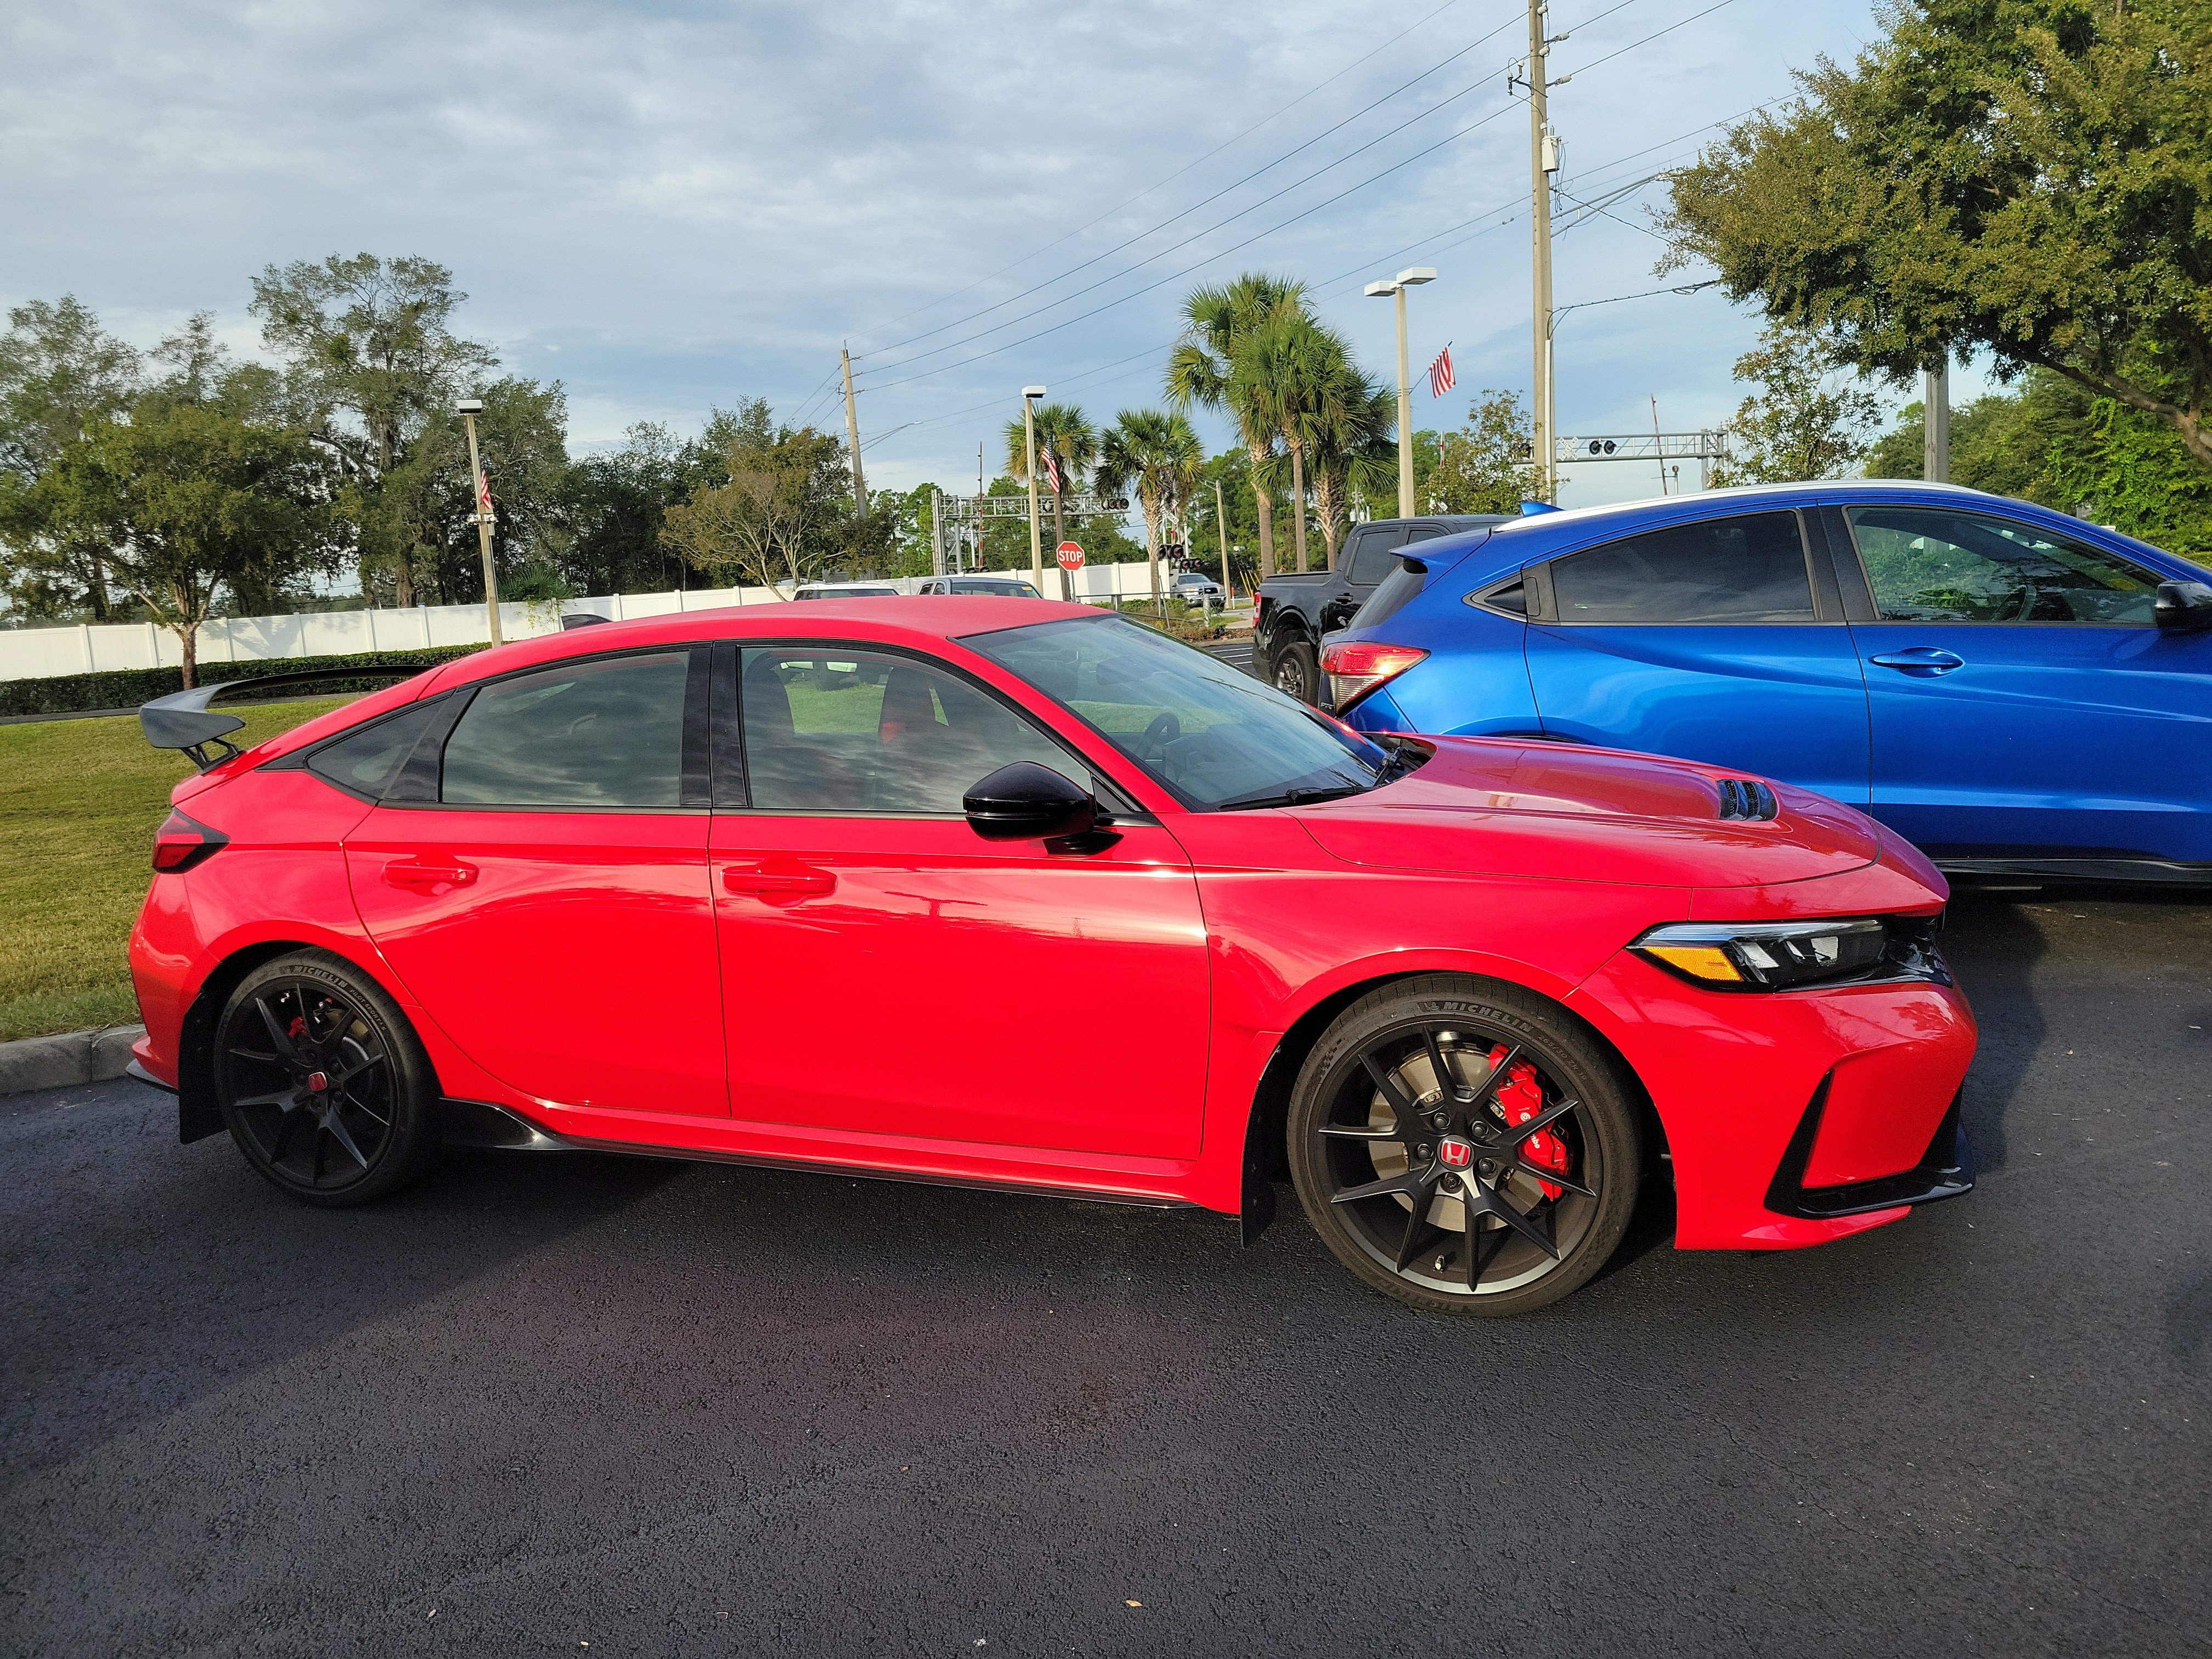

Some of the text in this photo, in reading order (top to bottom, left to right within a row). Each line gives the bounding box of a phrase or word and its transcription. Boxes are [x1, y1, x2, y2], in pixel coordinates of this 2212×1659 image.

[1059, 550, 1082, 562] STOP
[294, 965, 348, 988] MICHELIN
[350, 989, 365, 1003] PILOT
[365, 1003, 381, 1022] SPORT
[1443, 1002, 1533, 1033] MICHELIN
[1538, 1035, 1567, 1058] 265/30
